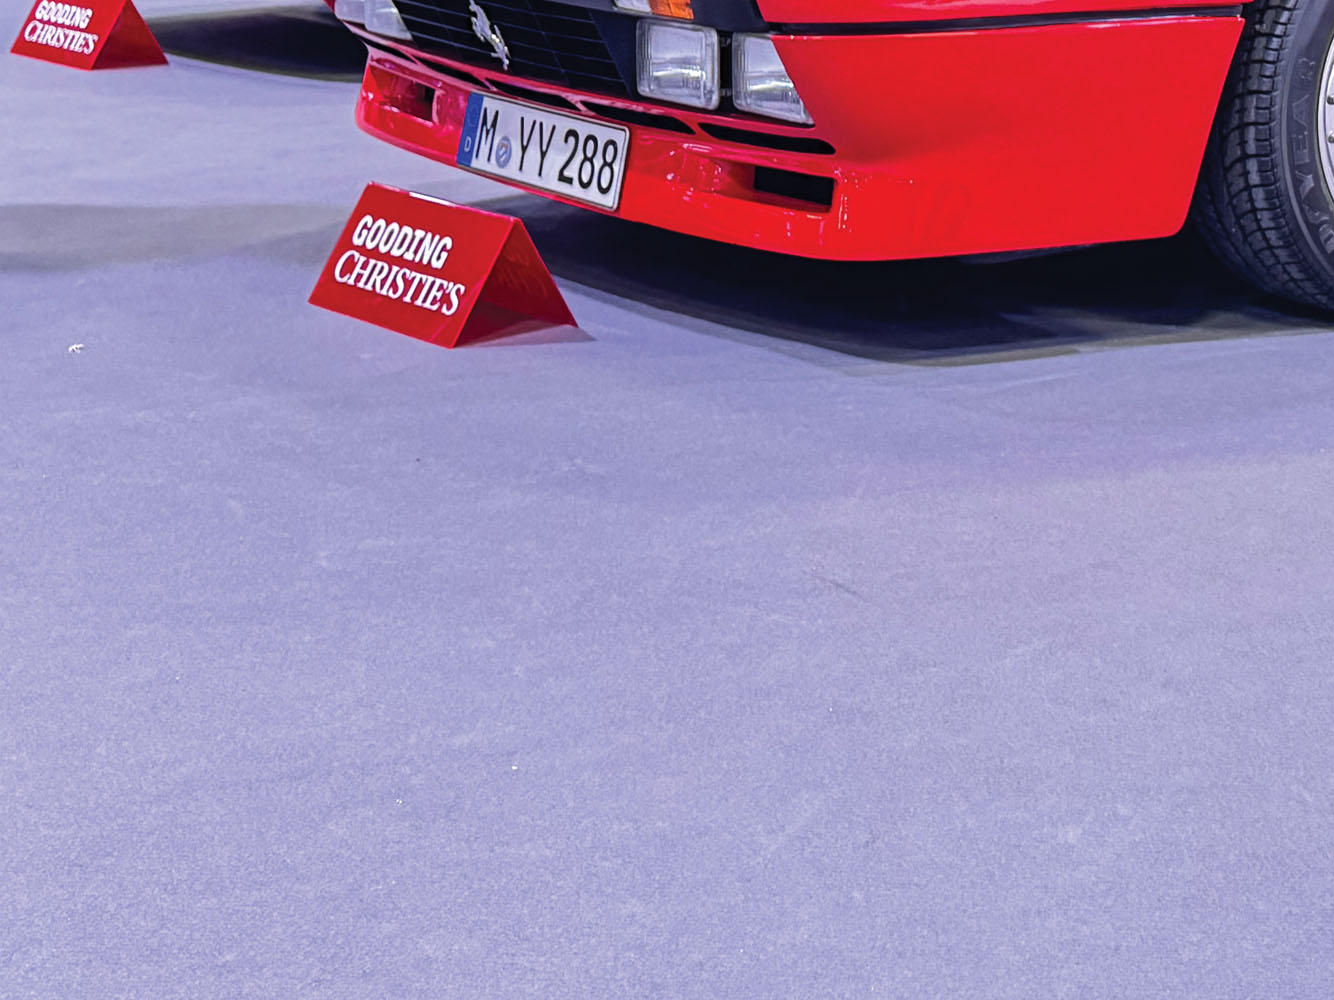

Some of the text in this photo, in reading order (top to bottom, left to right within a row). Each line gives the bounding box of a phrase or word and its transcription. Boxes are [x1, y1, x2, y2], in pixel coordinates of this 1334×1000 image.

[34, 0, 93, 30] GOODING
[463, 136, 472, 153] D
[475, 107, 618, 195] M YY 288
[352, 214, 453, 270] GOODING
[334, 249, 466, 316] CHRISTIE'S
